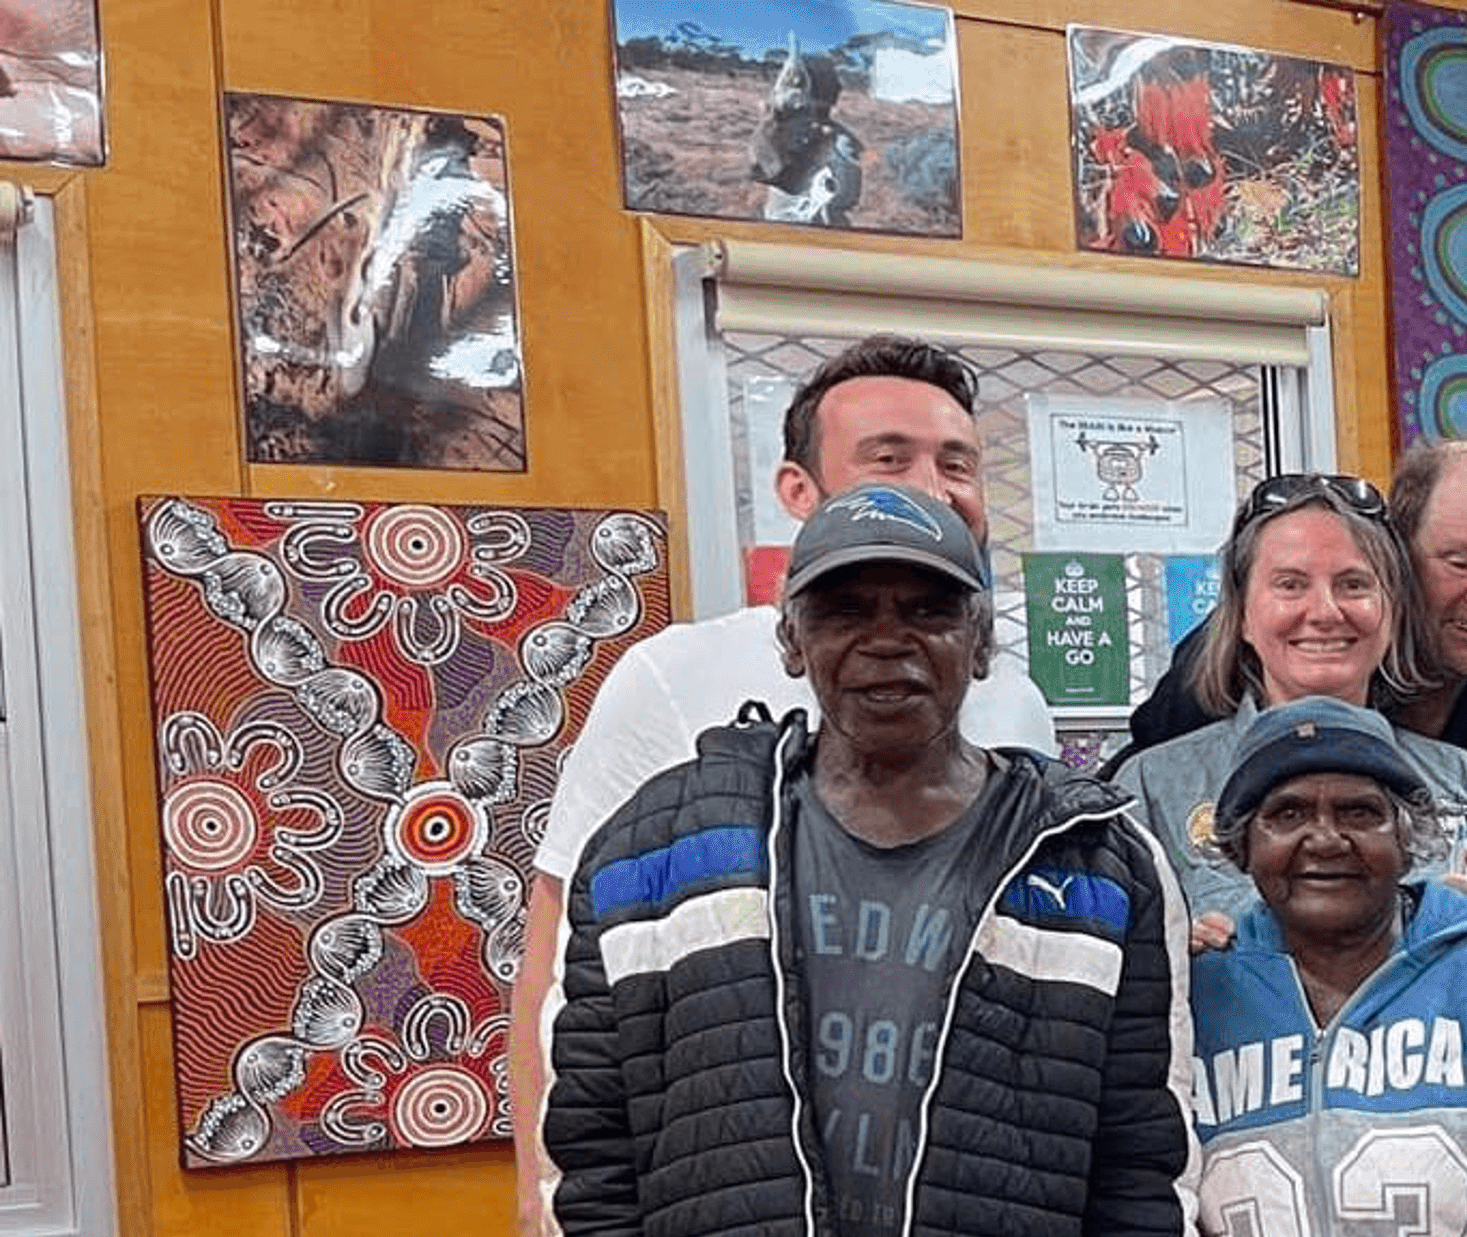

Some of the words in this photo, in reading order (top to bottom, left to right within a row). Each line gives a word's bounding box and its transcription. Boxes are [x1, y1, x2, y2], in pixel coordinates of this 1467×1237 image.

[1054, 577, 1099, 595] KEEP
[1051, 596, 1104, 613] CALM
[1066, 615, 1092, 627] AND
[1047, 629, 1095, 647] HAVE
[1097, 629, 1112, 647] A
[1065, 650, 1095, 665] GO
[1186, 1016, 1465, 1127] AMERICA
